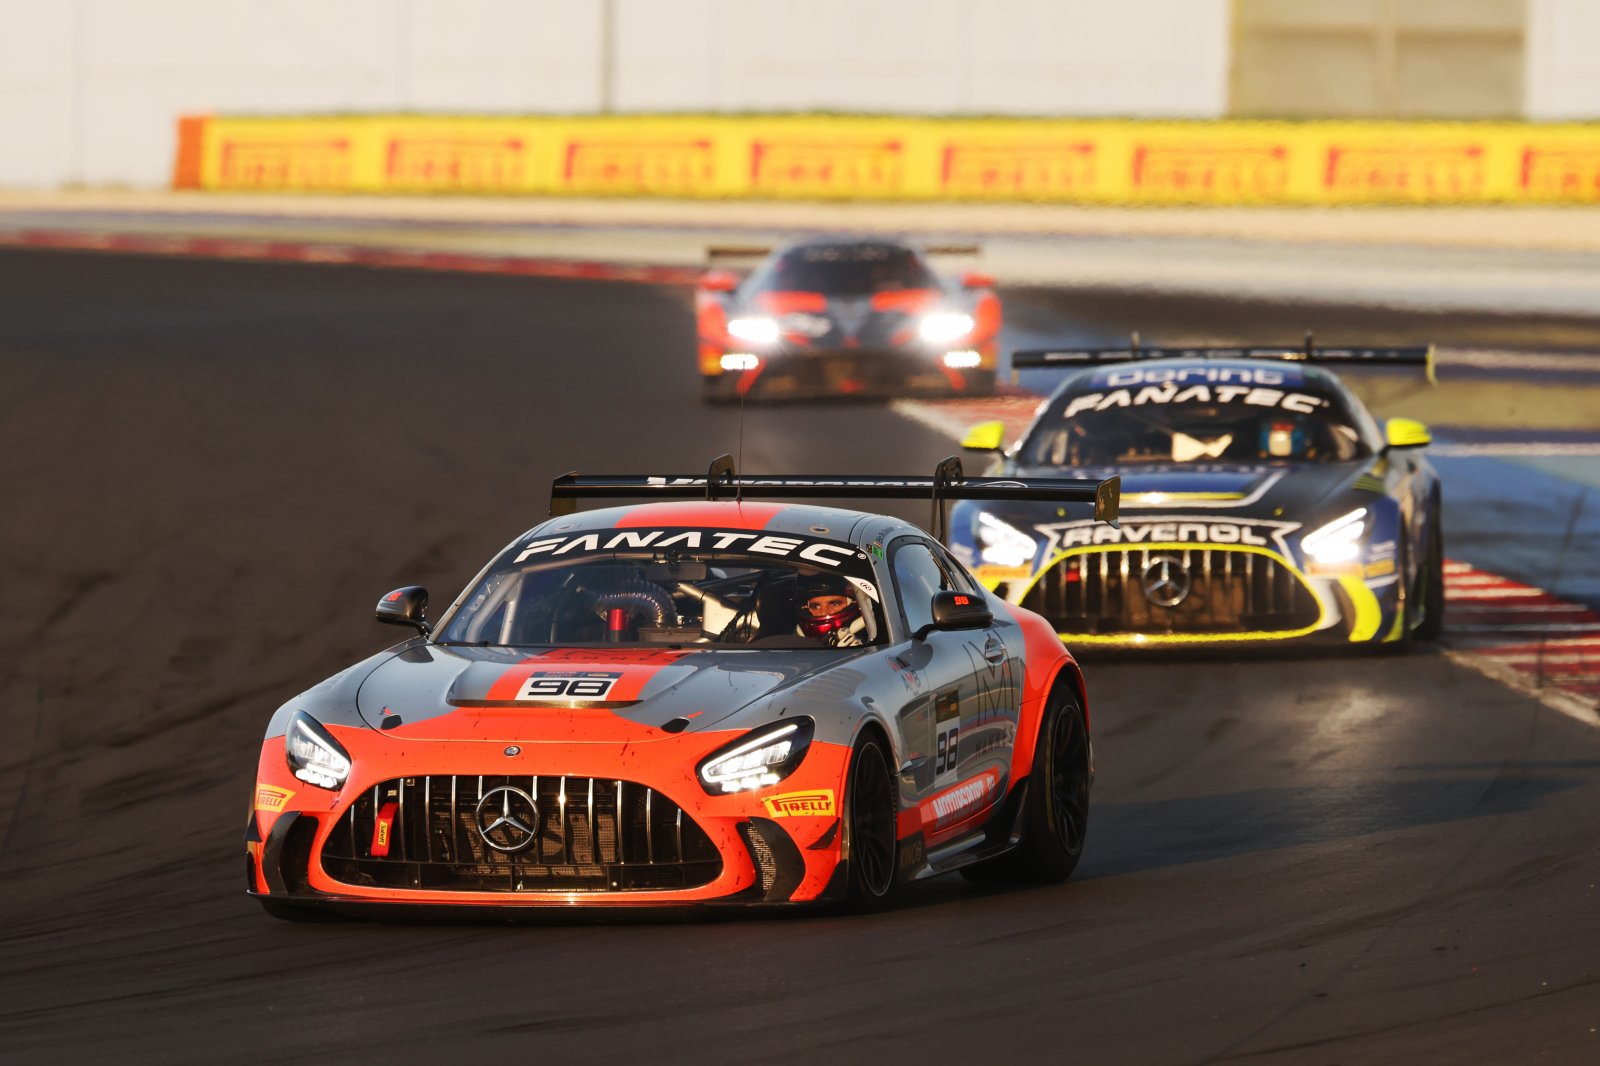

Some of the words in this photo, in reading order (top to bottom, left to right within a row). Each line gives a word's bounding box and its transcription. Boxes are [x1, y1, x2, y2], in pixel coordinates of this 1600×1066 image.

[1063, 385, 1323, 419] FANATEC
[1062, 523, 1267, 547] RAVENOL
[512, 530, 855, 567] FANATEC
[954, 596, 969, 605] 98
[528, 680, 612, 696] 98
[936, 727, 959, 776] 98
[256, 788, 288, 807] PIRELLI
[771, 795, 829, 812] PIRELLI
